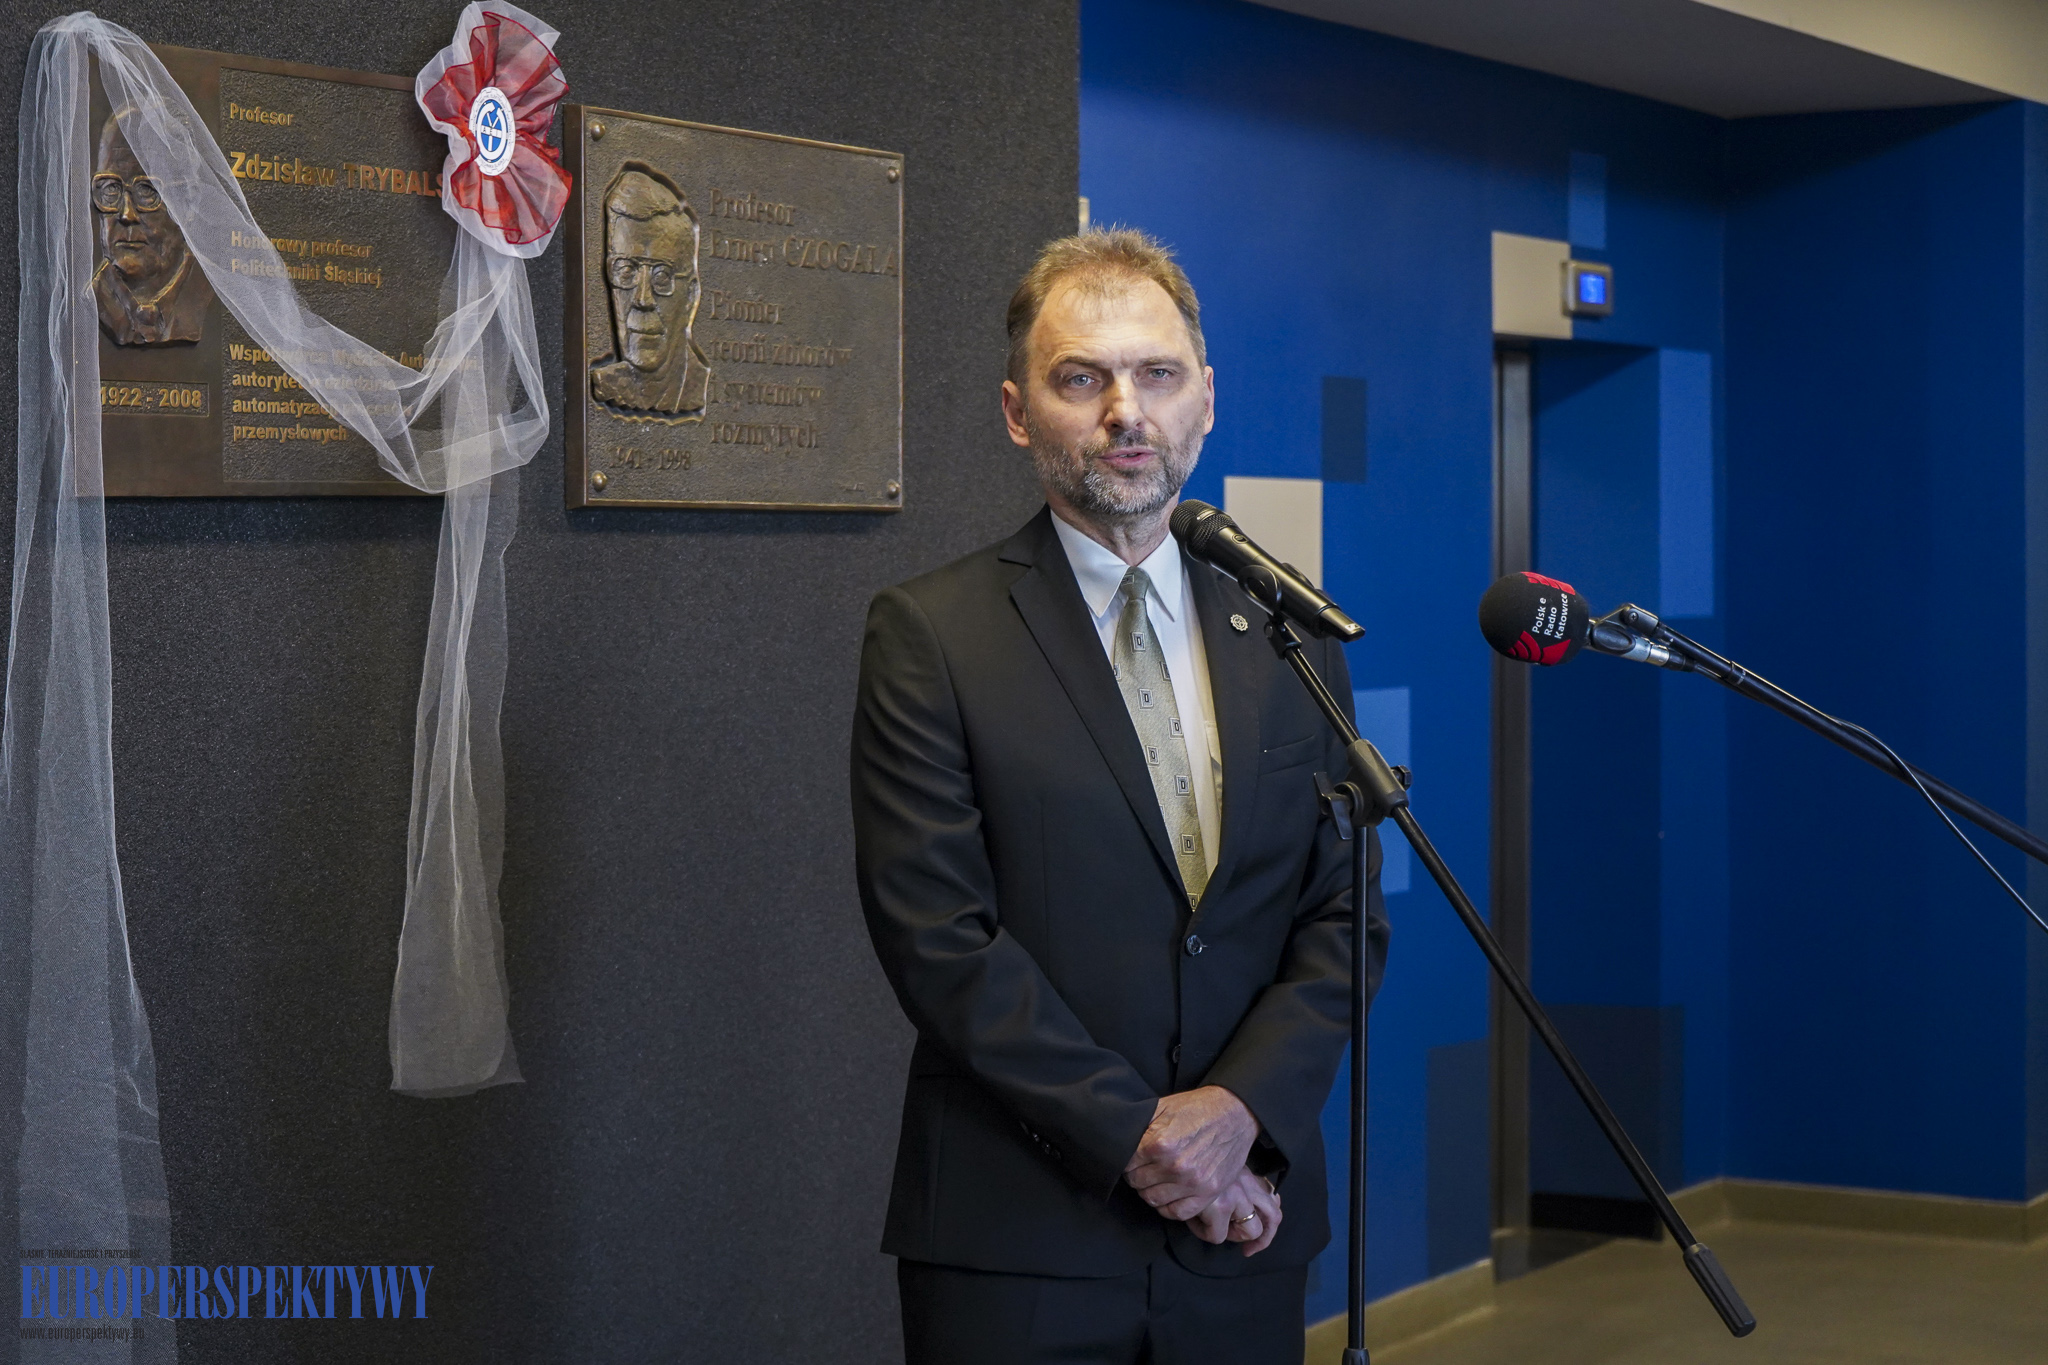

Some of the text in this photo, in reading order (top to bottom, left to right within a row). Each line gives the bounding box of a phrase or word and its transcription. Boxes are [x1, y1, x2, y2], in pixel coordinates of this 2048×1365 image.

[230, 102, 294, 126] Profesor
[231, 151, 335, 187] Zdzisław
[312, 239, 373, 258] profesor
[324, 261, 382, 288] Śląskiej
[100, 386, 142, 407] 1922
[159, 388, 202, 408] 2008
[1532, 597, 1547, 634] Polske
[1543, 606, 1558, 636] Radio
[1554, 593, 1568, 639] Katowice
